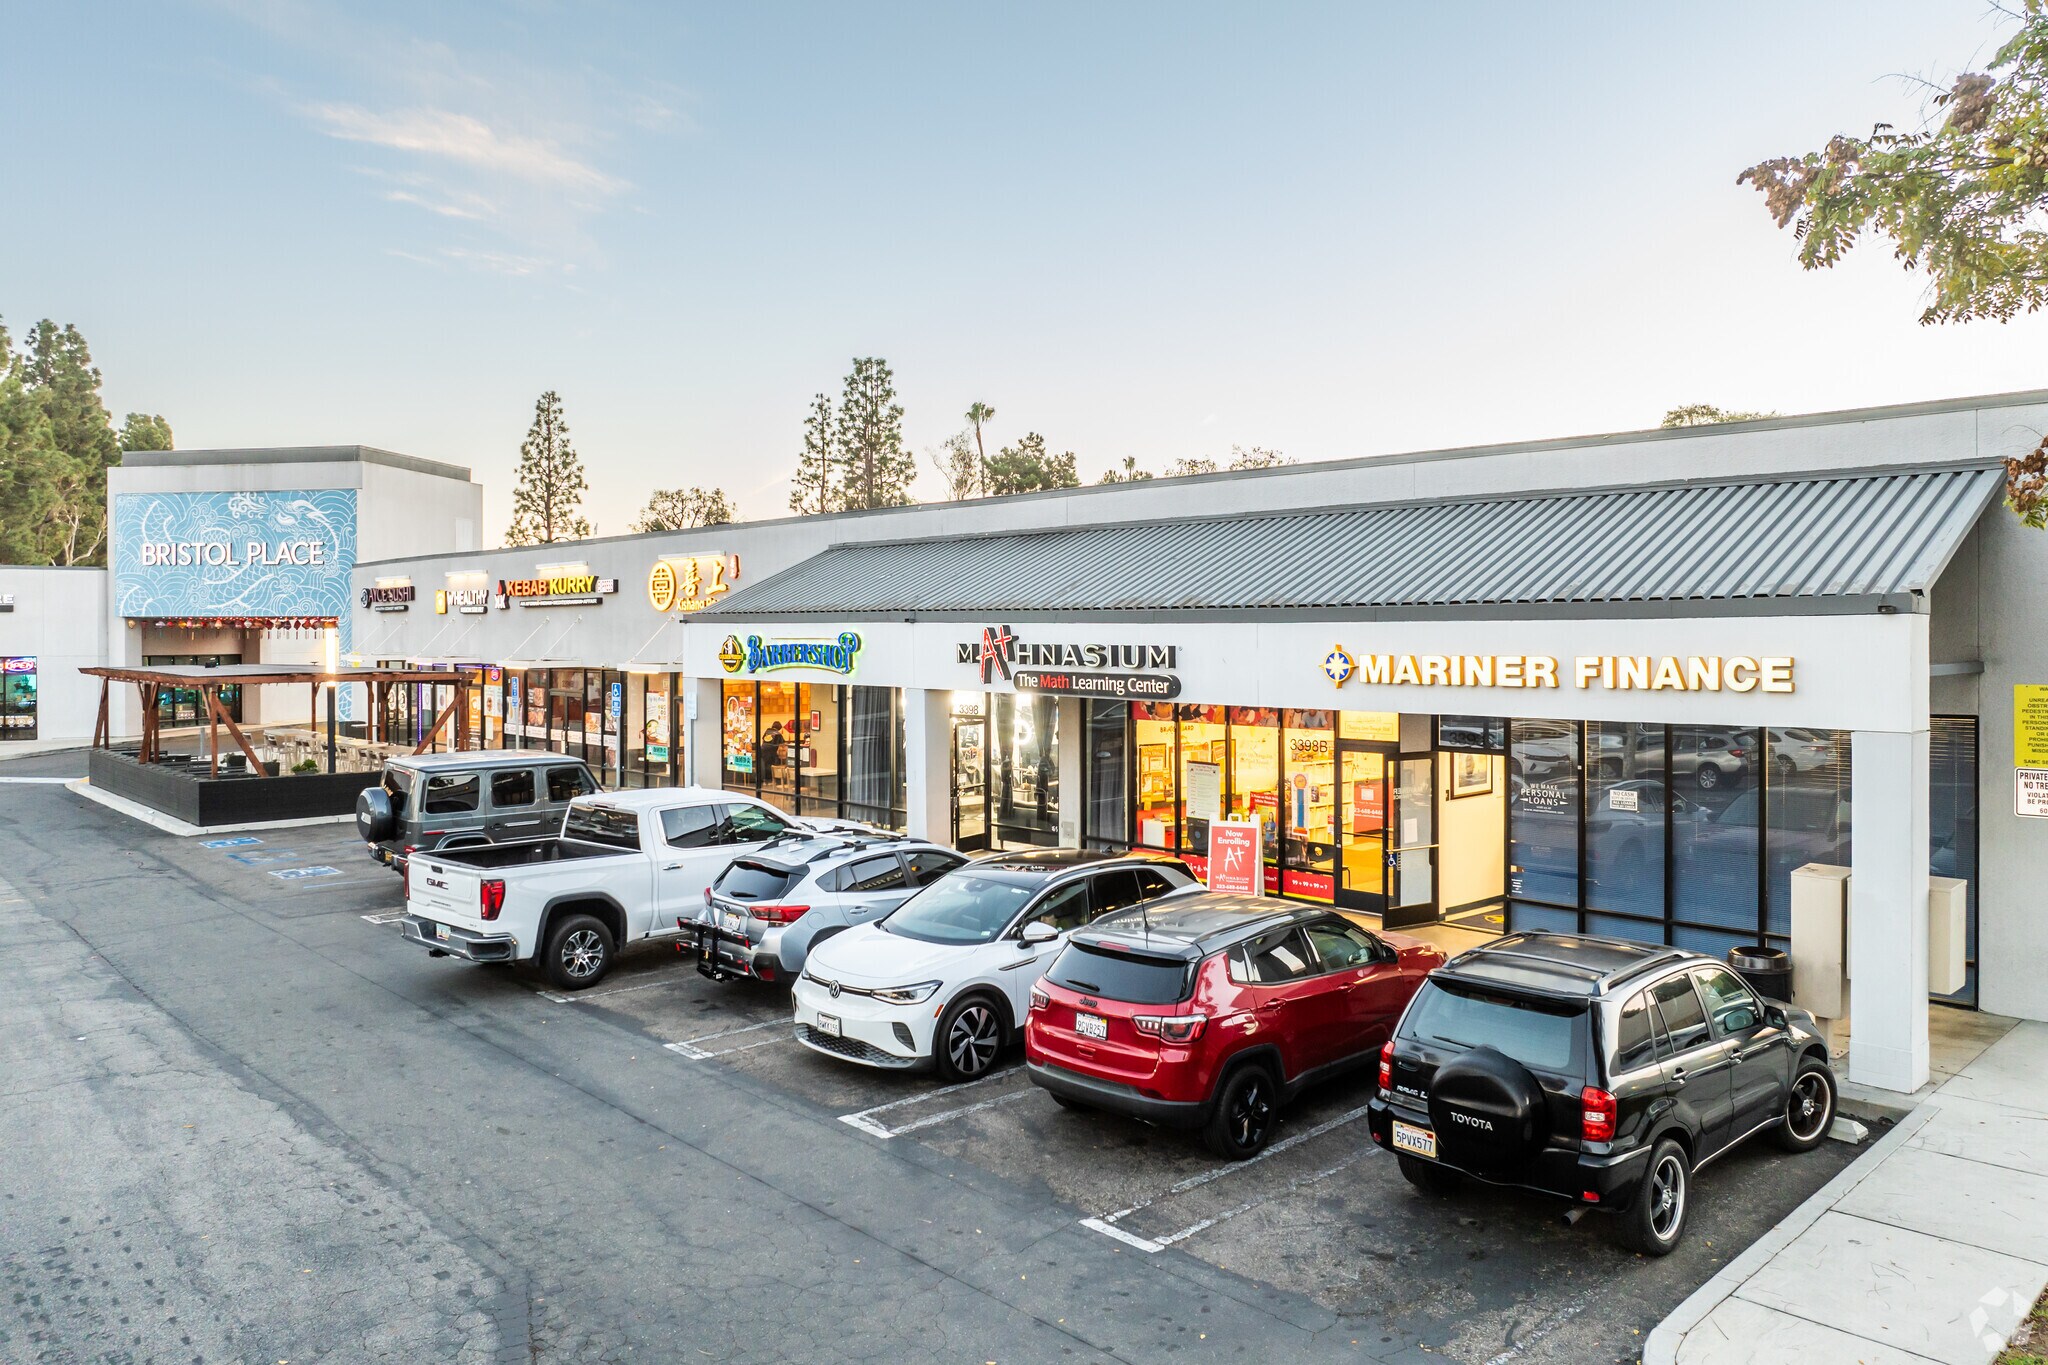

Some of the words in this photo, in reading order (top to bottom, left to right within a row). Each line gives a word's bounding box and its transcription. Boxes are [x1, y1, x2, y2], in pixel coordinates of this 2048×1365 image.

[141, 541, 240, 566] BRISTOL
[247, 541, 325, 566] PLACE
[369, 587, 388, 602] AYCE
[388, 586, 413, 602] SUSHI
[506, 579, 547, 597] KEBAB
[549, 575, 595, 595] KURRY
[446, 589, 488, 606] WHEALTHY
[746, 631, 858, 675] BARBERSHOP
[1358, 653, 1560, 690] MARINER
[1574, 655, 1797, 694] FINANCE
[1016, 673, 1038, 688] The
[1040, 673, 1070, 689] Math
[1072, 675, 1125, 695] Learning
[1127, 678, 1169, 694] Center
[960, 704, 979, 715] 3398
[1290, 738, 1328, 752] 3398B
[2019, 772, 2048, 781] PRIVATE
[1520, 788, 1567, 799] PERSONAL
[2023, 781, 2034, 789] NO
[2036, 782, 2048, 790] TRE
[1528, 797, 1559, 806] LOANS
[1217, 836, 1250, 847] Enrolling
[1224, 846, 1245, 872] A+
[426, 877, 449, 890] GMC
[1079, 996, 1098, 1008] Jeep
[1450, 1111, 1494, 1131] TOYOTA
[1396, 1131, 1433, 1153] 5PVX577
